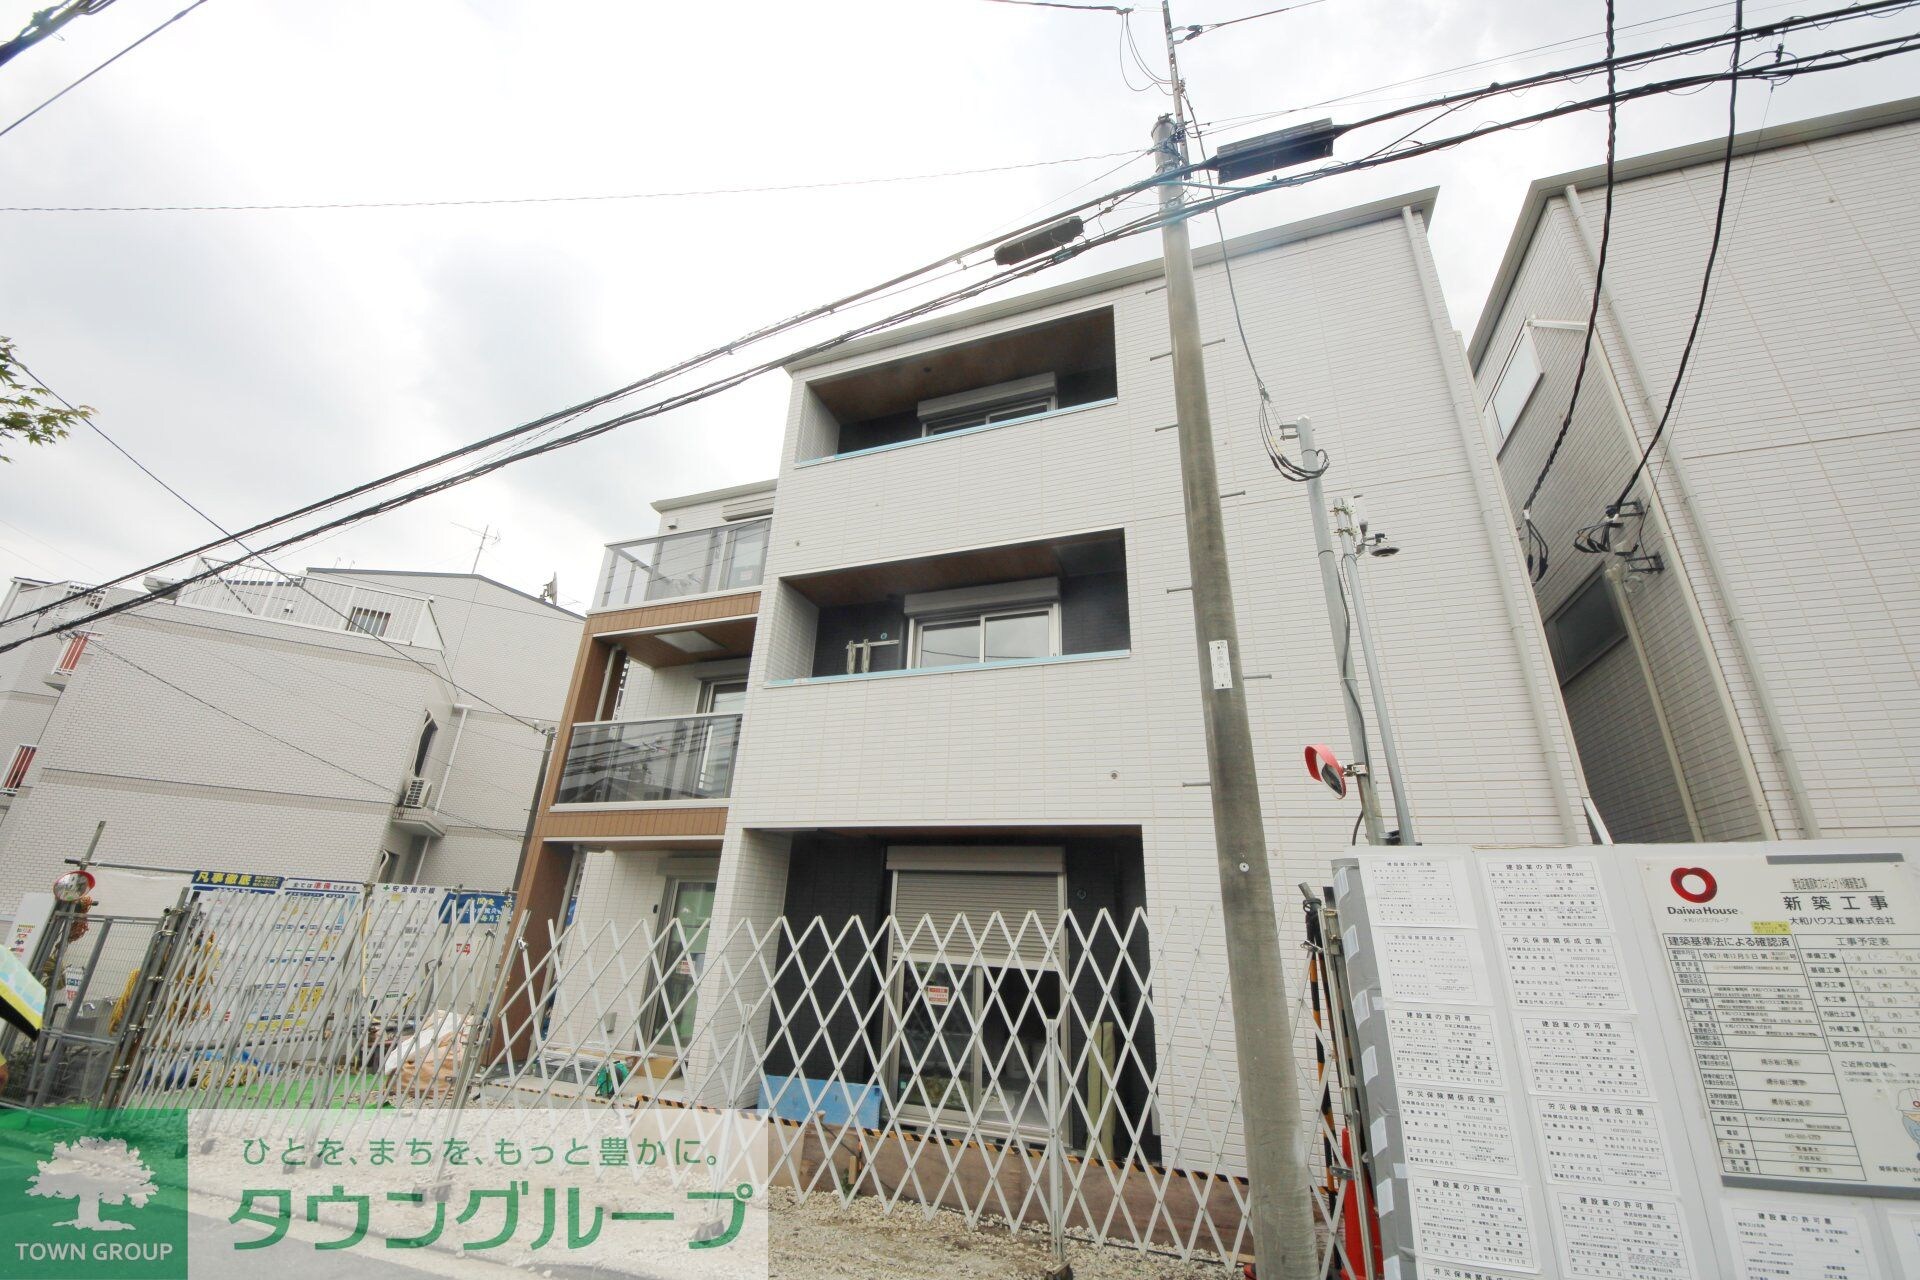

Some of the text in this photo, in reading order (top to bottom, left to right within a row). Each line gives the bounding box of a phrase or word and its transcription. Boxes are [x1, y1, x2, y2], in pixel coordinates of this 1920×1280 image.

[197, 872, 252, 885] 凡事徹底
[392, 885, 436, 894] 安全掲示板
[1783, 896, 1889, 911] 新築工事
[1789, 916, 1895, 925] 大和ハウス工業株式会社
[1668, 936, 1790, 947] 建築基準法による確認済
[1837, 937, 1890, 946] 工事予定表
[1407, 1012, 1470, 1021] 建設業の許可票
[1542, 1021, 1611, 1029] 建設業の許可票
[1841, 1060, 1896, 1068] ご近所の皆様へ
[1407, 1090, 1495, 1104] 労災保険関係成立票
[1548, 1103, 1644, 1116] 労災保険関係成立票
[1433, 1180, 1501, 1194] 建設業の許可票
[1580, 1197, 1654, 1210] 建設業の許可票
[1758, 1213, 1832, 1225] 建設業の許可票
